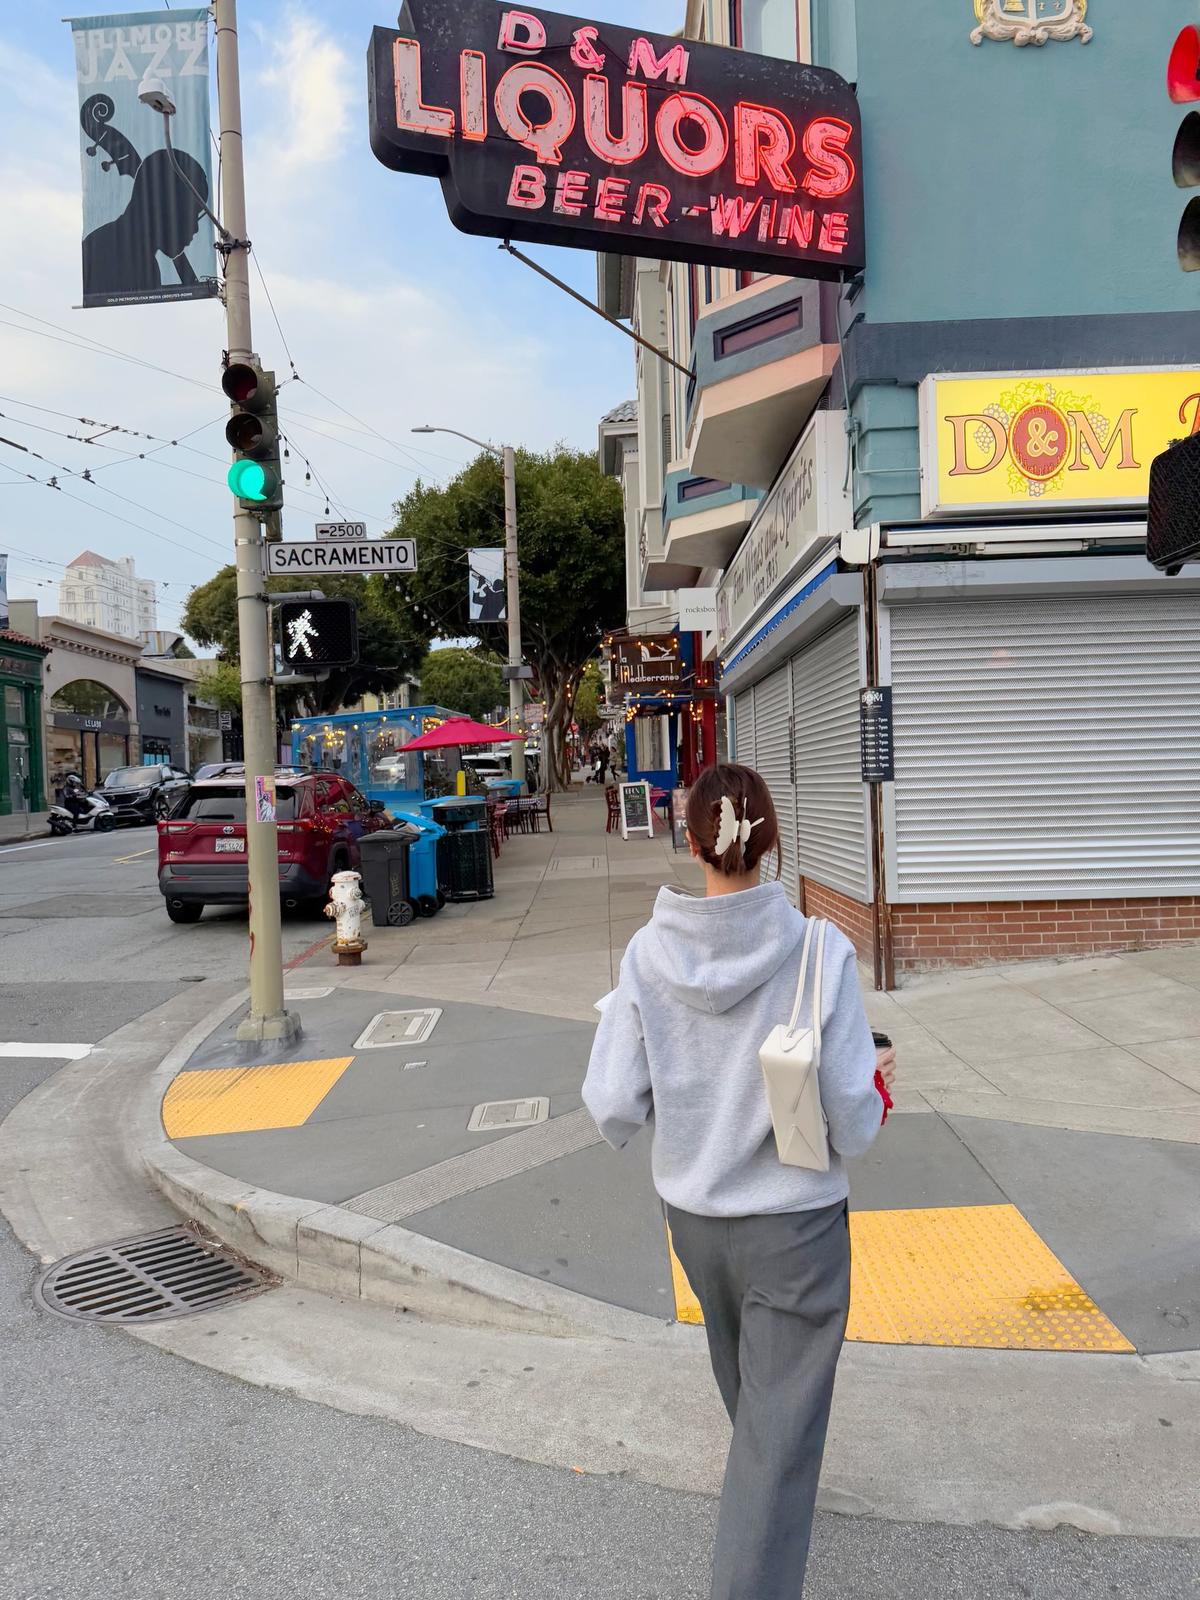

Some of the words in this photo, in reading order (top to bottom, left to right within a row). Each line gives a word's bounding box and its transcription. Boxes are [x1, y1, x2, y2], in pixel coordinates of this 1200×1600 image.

[73, 20, 208, 50] FILLMORE
[499, 10, 547, 56] D
[569, 26, 607, 72] &
[625, 37, 691, 86] M
[78, 41, 209, 85] JAZZ
[392, 36, 856, 199] LIQUORS
[780, 457, 813, 550] Spirits
[329, 524, 363, 537] 2500
[275, 545, 409, 567] SACRAMENTO
